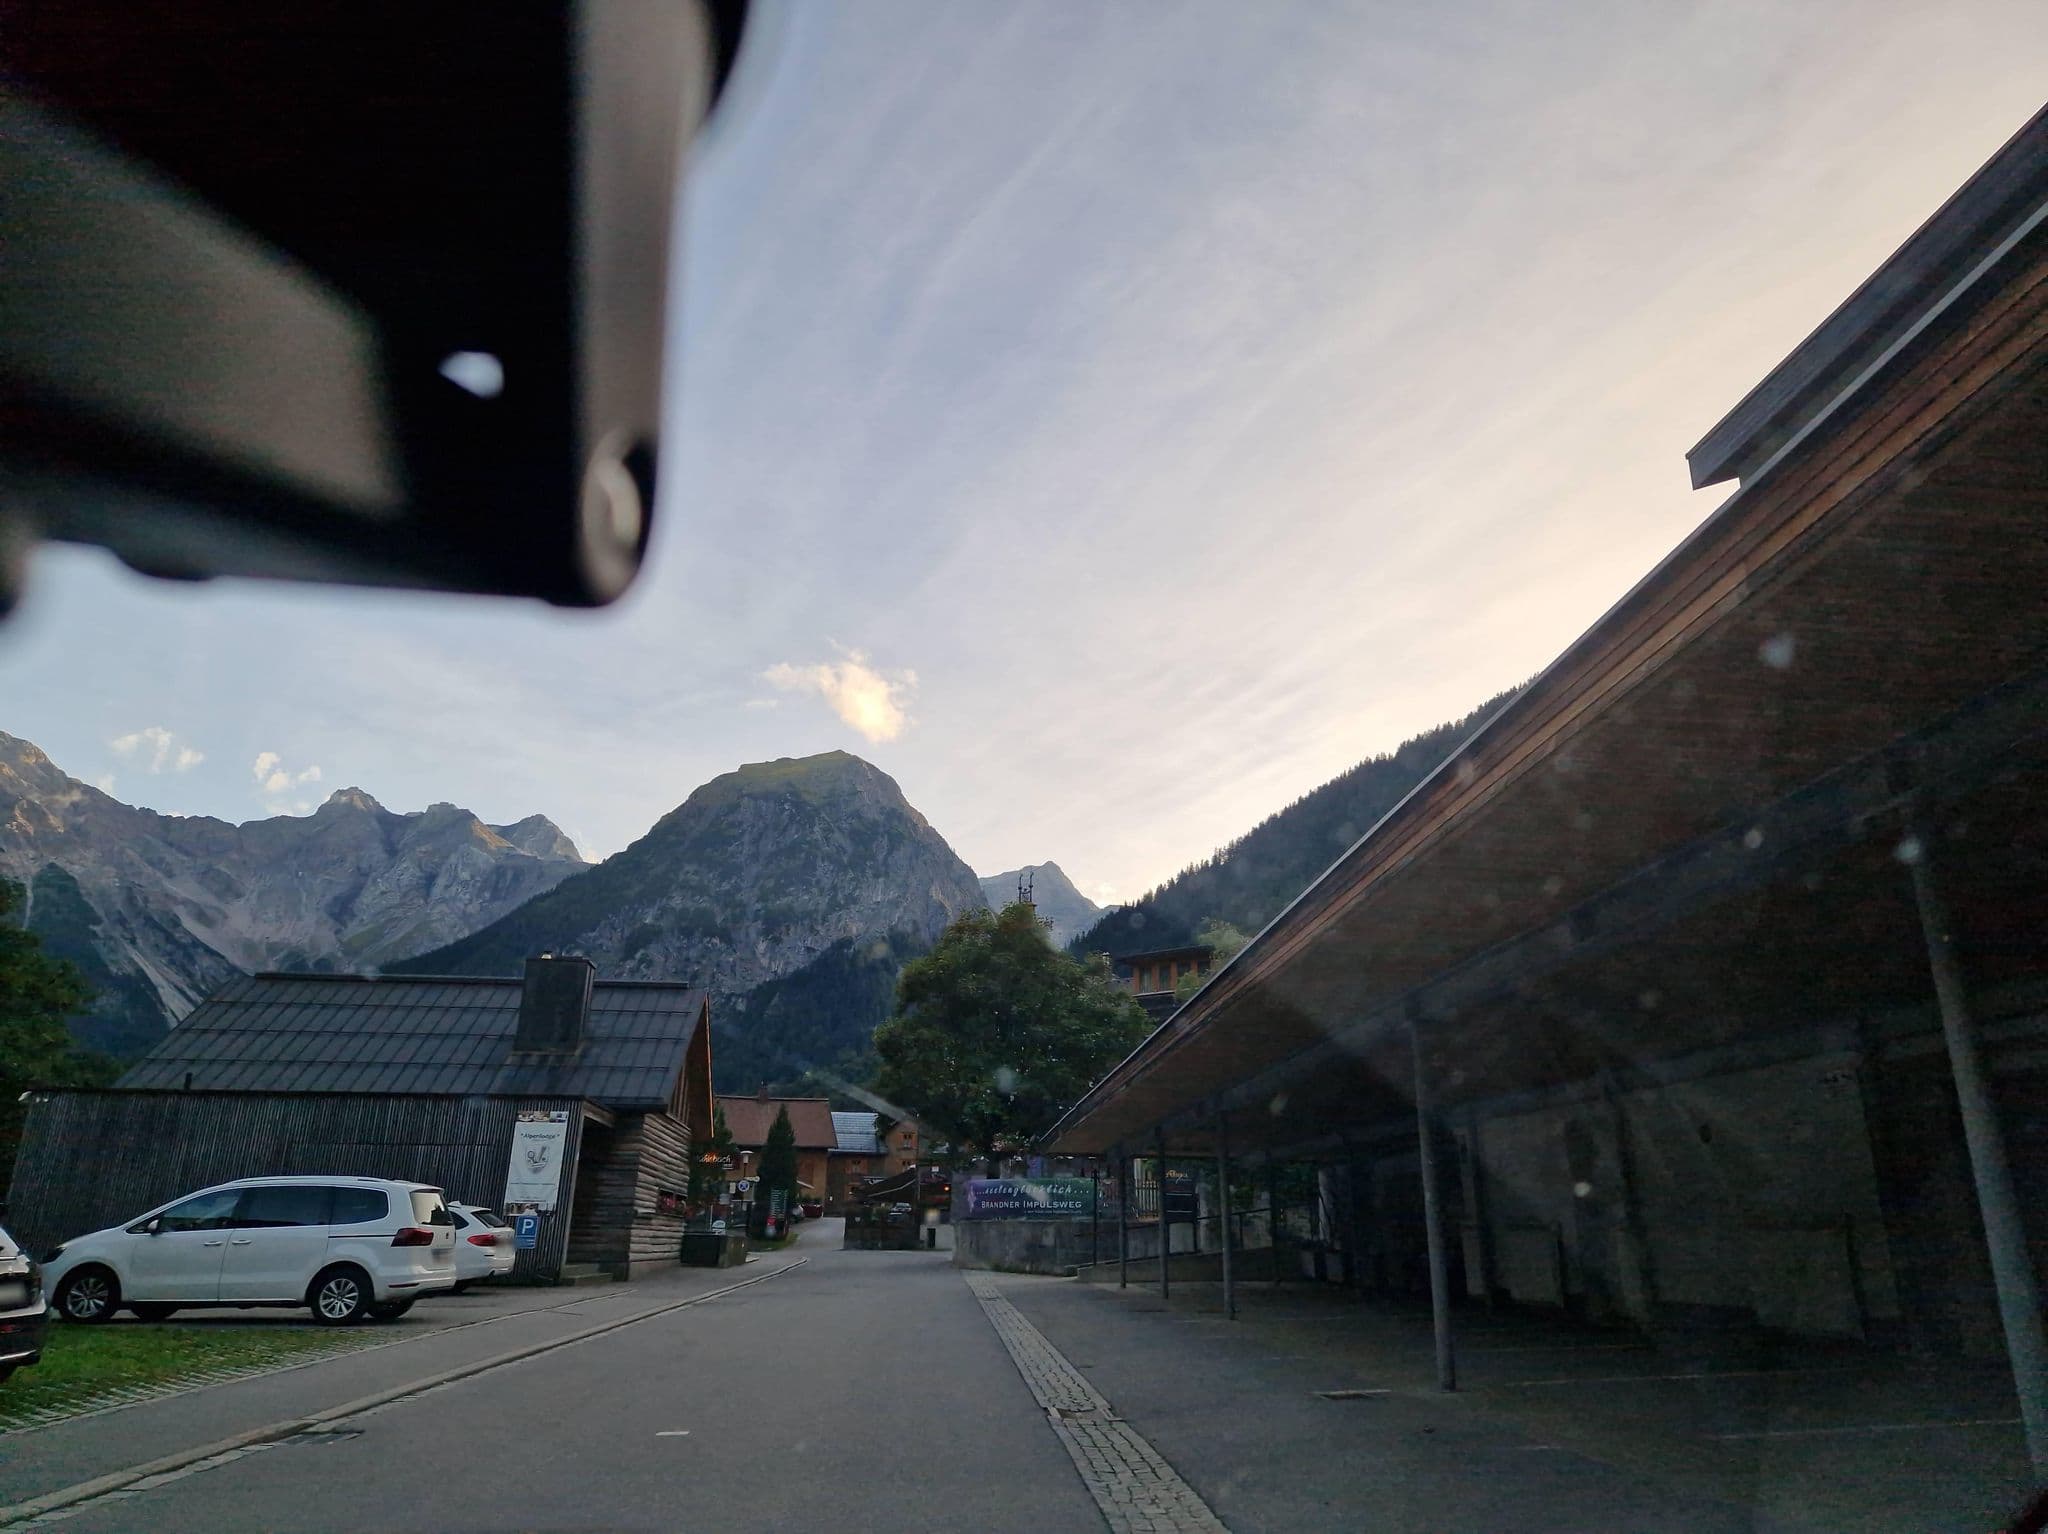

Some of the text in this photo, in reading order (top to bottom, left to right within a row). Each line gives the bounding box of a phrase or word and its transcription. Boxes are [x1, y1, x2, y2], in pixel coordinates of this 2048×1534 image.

[981, 1200, 1082, 1209] BRANDNER IMPULSWEG
[522, 1219, 534, 1234] P
